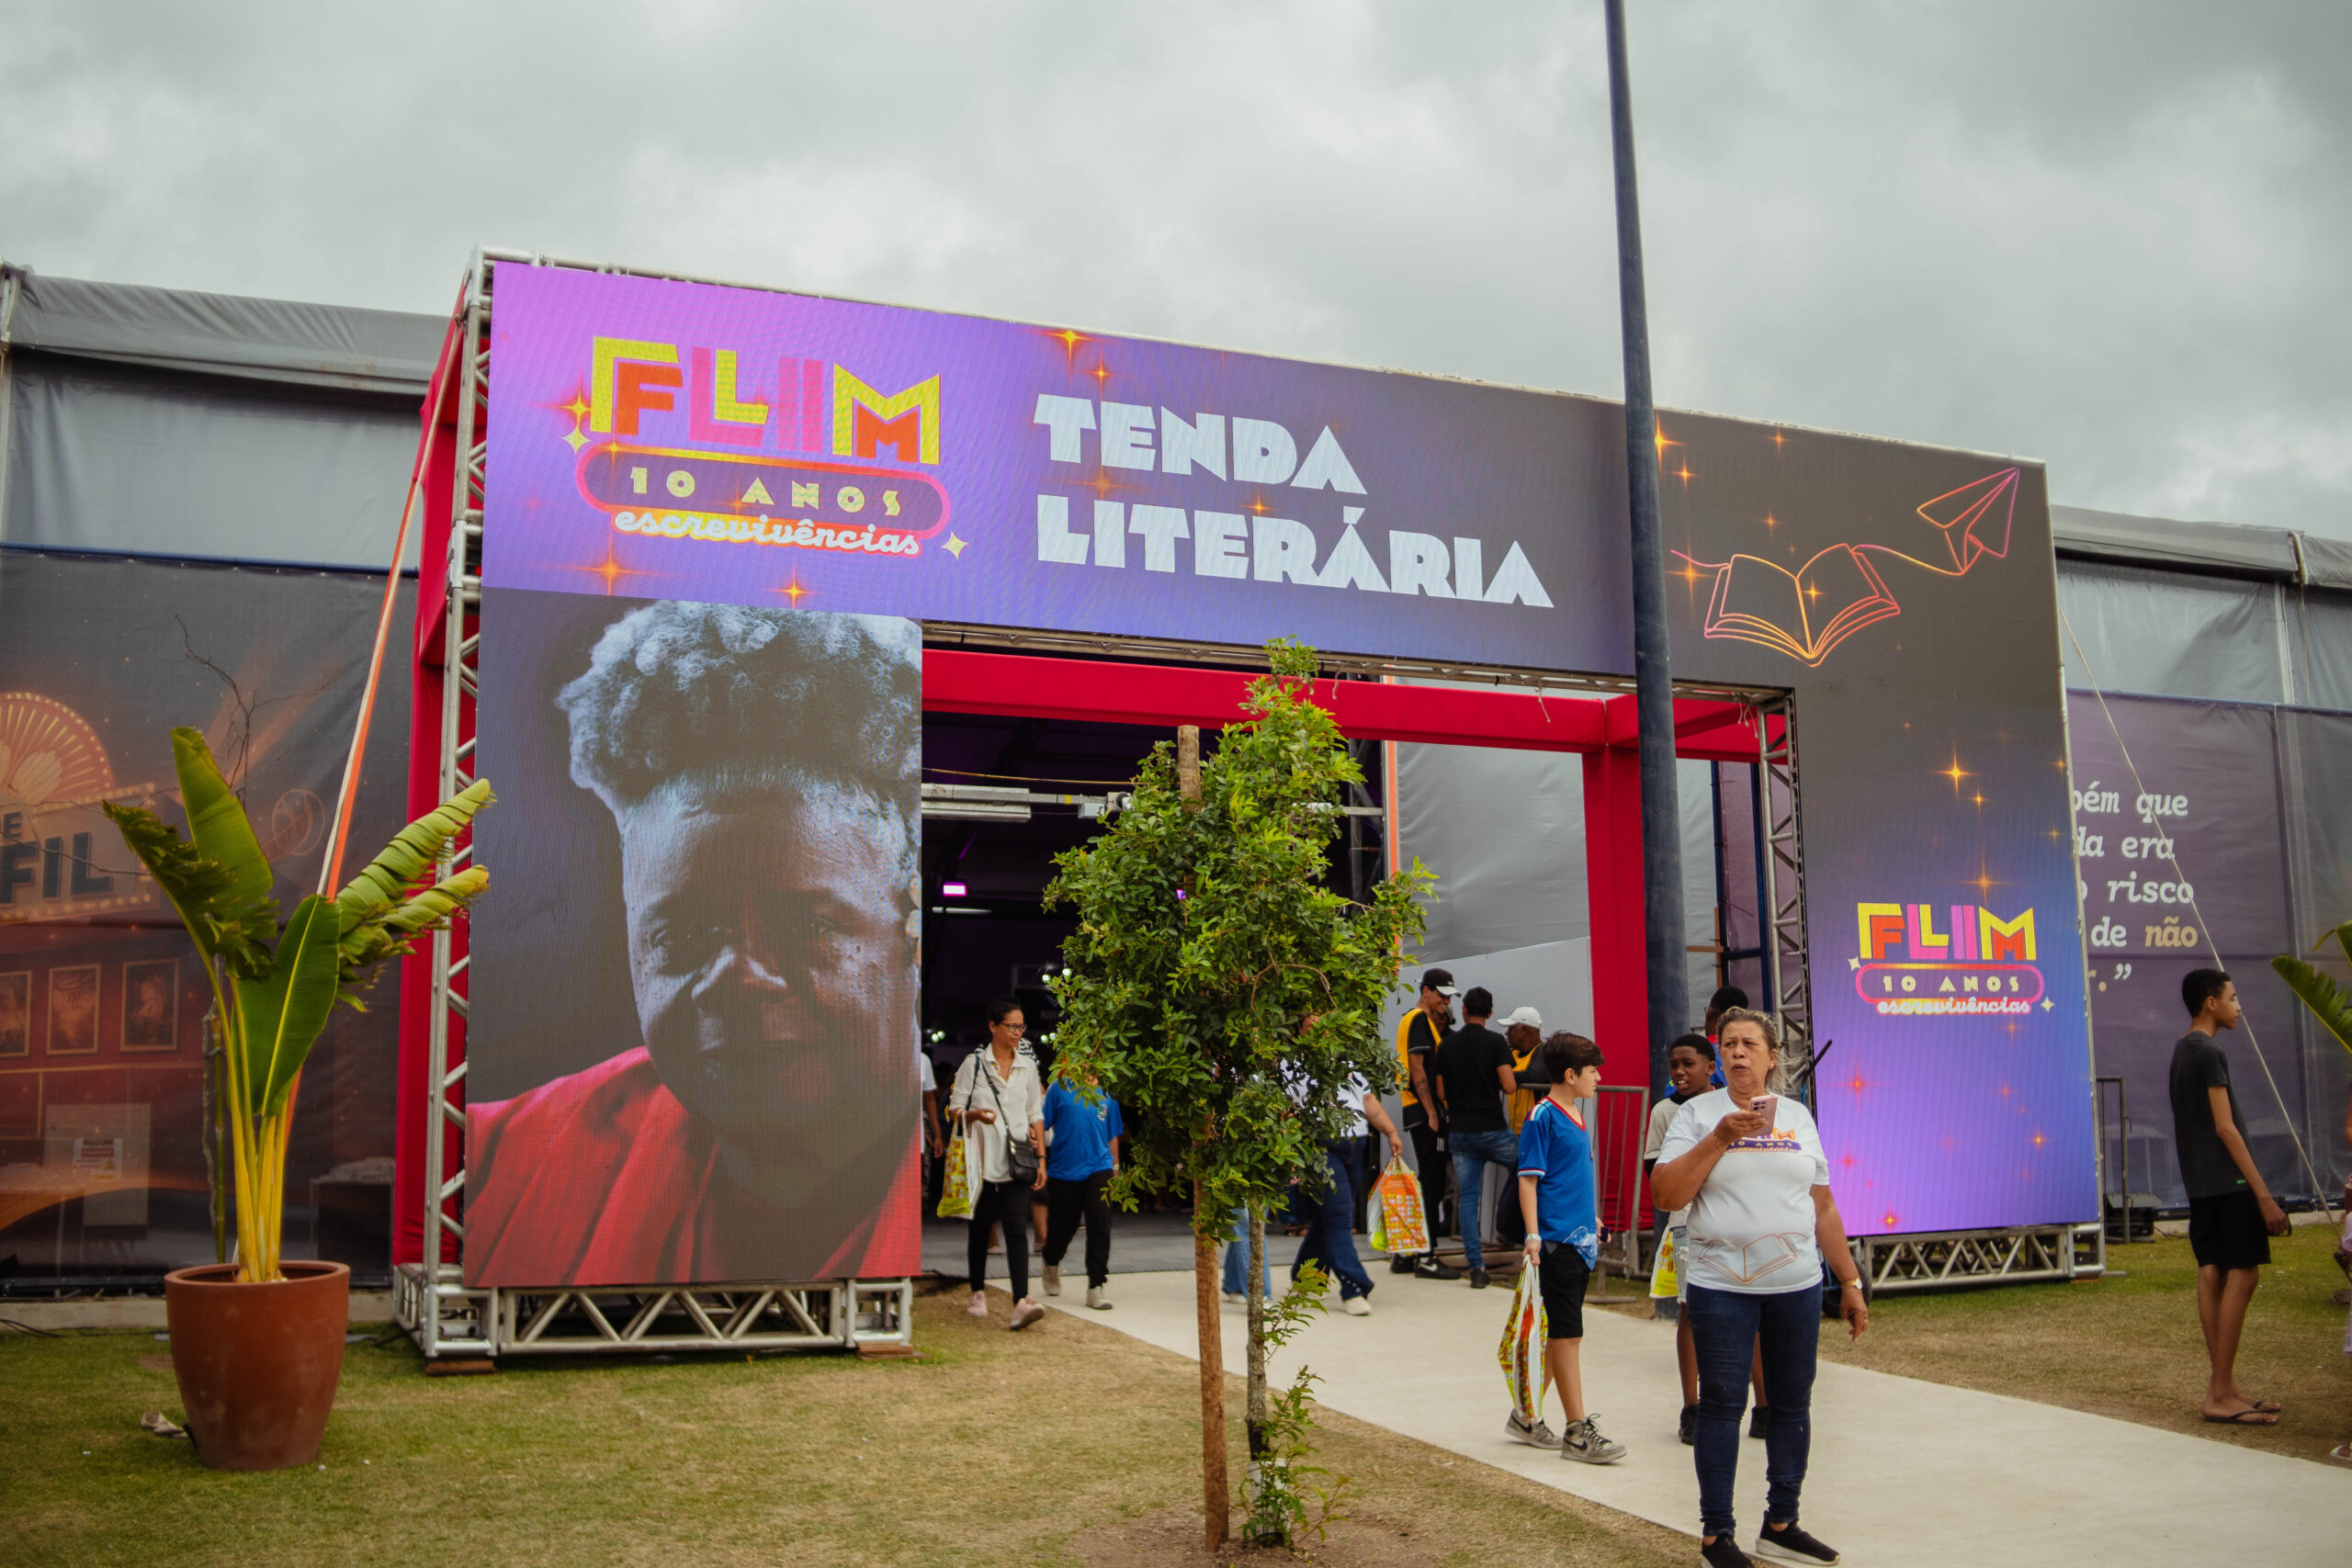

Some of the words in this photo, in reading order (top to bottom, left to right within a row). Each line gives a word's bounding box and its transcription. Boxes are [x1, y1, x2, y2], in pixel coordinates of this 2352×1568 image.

[590, 336, 940, 465] FLIM
[1034, 393, 1367, 495] TENDA
[630, 466, 696, 498] 10
[741, 477, 901, 516] ANOS
[615, 510, 921, 556] escrevivências
[1037, 494, 1554, 608] LITERÁRIA
[2136, 794, 2189, 824] que
[2121, 836, 2176, 860] era
[2108, 870, 2195, 904] risco
[1858, 902, 2037, 961] FLIM
[2091, 916, 2128, 947] de
[2144, 916, 2199, 948] não
[1883, 976, 1917, 992] 10
[1939, 976, 2019, 992] ANOS
[1877, 996, 2030, 1014] escrevivências
